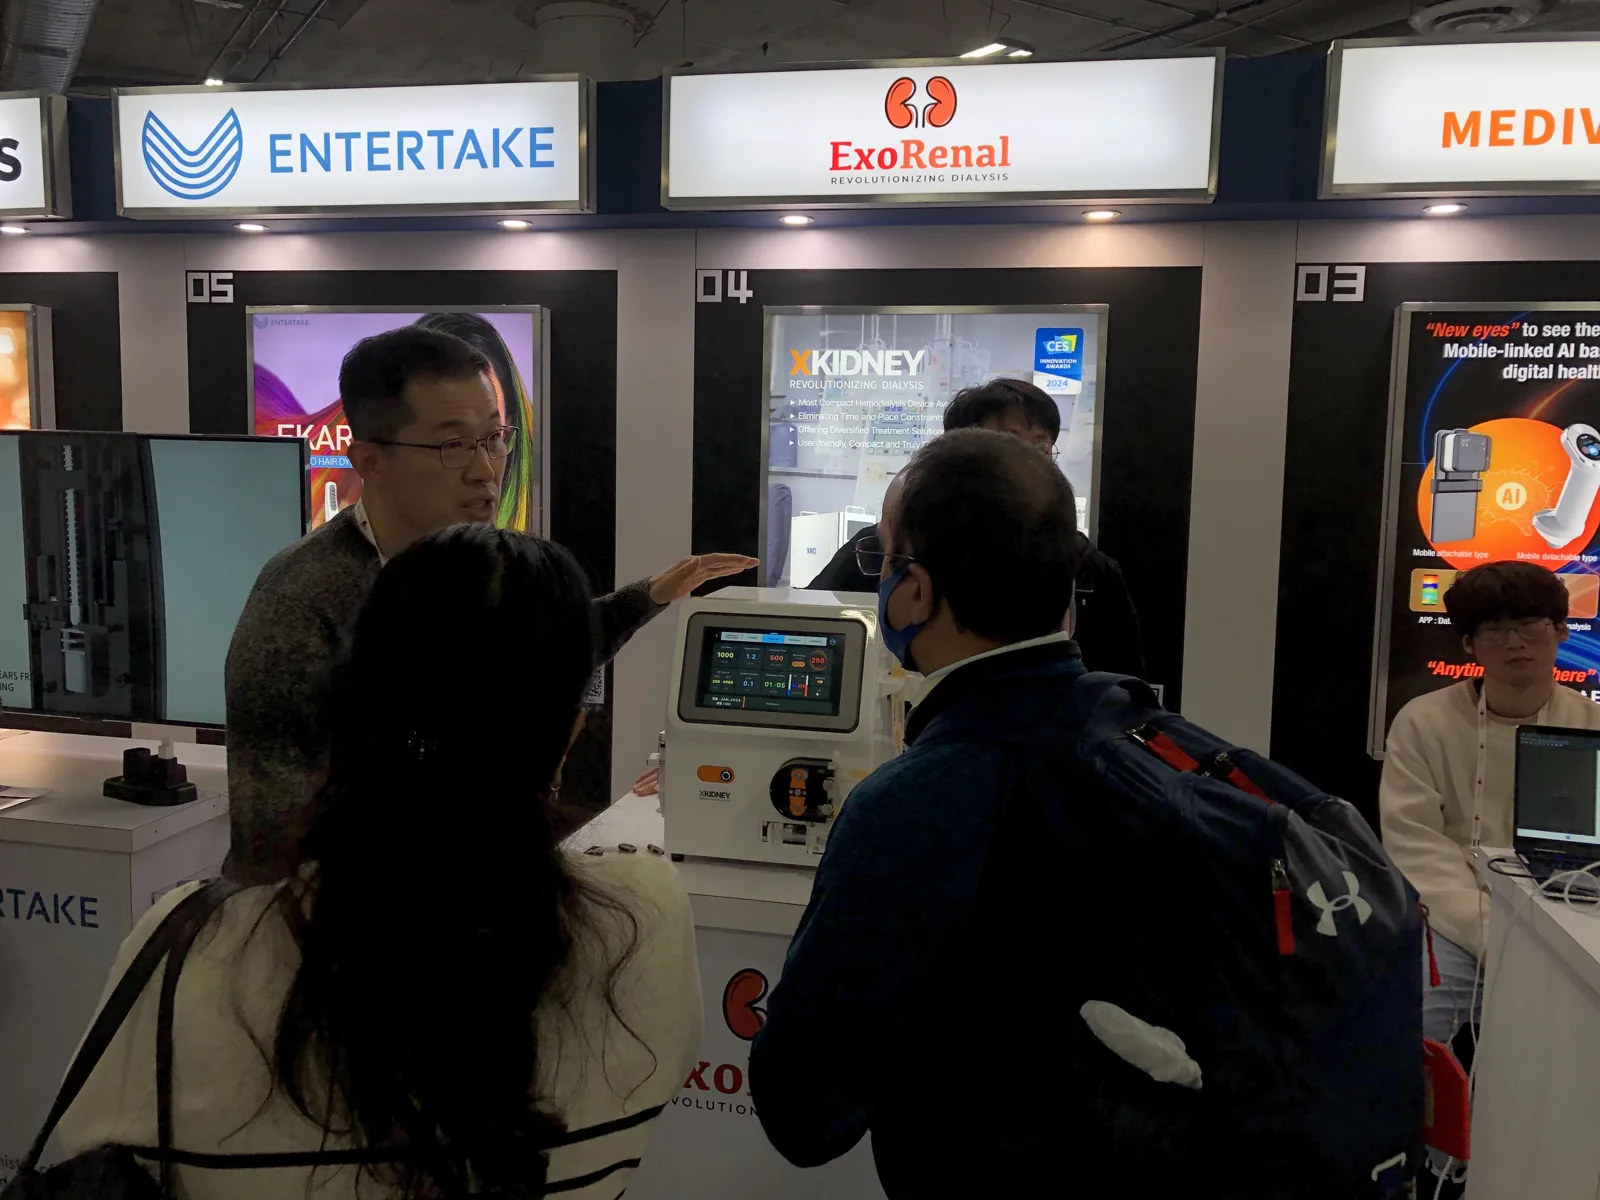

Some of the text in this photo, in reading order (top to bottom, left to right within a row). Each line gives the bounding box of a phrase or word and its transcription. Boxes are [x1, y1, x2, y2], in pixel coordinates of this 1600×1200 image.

[1441, 108, 1600, 148] MEDIV
[269, 127, 555, 173] ENTERTAKE
[829, 136, 1011, 171] ExoRenal
[830, 172, 1009, 185] REVOLUTIONIZING DIALYSIS
[187, 272, 234, 303] 05
[697, 269, 754, 304] 04
[1296, 265, 1366, 301] 03
[1521, 323, 1538, 337] to
[1542, 324, 1571, 337] see
[1574, 322, 1600, 337] the
[1046, 341, 1070, 352] CES
[1442, 343, 1600, 358] Mobile-linked AI ba
[789, 349, 926, 376] XKIDNEY
[1502, 364, 1600, 381] digital healt
[789, 380, 925, 390] REVOLUTIONIZING DIALYSIS
[1046, 379, 1069, 388] 2024
[819, 399, 854, 409] Compact
[855, 399, 906, 409] Hemodialysis
[907, 400, 935, 408] Device
[798, 412, 839, 421] Eliminating
[798, 426, 828, 435] Offering
[829, 426, 869, 435] Diversified
[871, 427, 910, 435] Treatment
[848, 440, 884, 449] Compact
[885, 441, 900, 449] and
[902, 441, 921, 450] Truly
[318, 457, 338, 466] HAIR
[1501, 488, 1520, 505] AI
[1412, 549, 1490, 559] Mobile attachable type
[1516, 552, 1598, 563] Mobile detachable type
[1418, 616, 1433, 624] APP
[699, 790, 732, 800] XKIDNEY
[0, 888, 99, 929] TAKE
